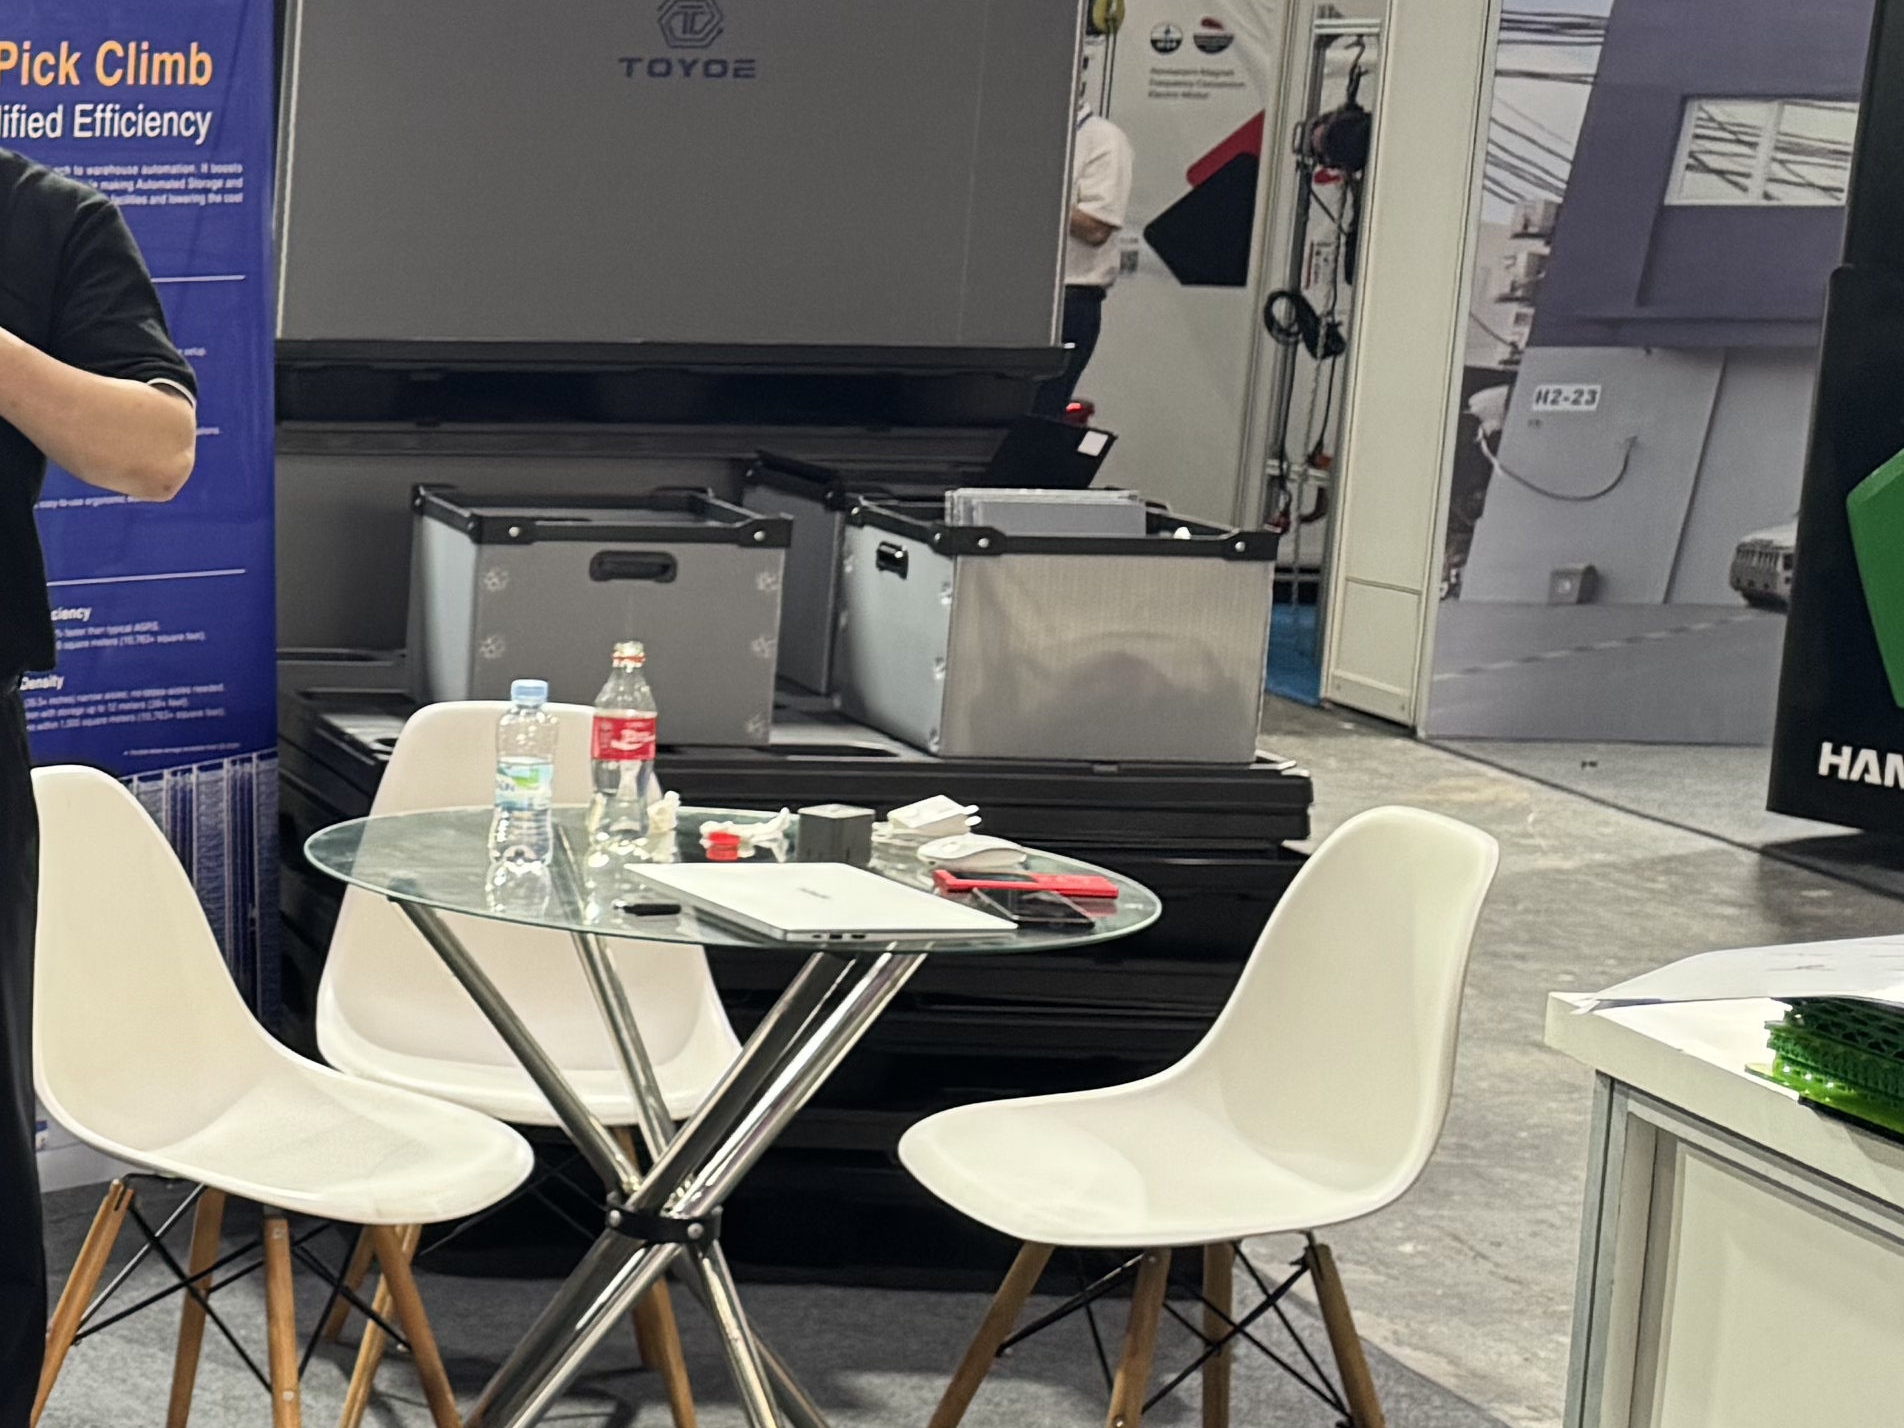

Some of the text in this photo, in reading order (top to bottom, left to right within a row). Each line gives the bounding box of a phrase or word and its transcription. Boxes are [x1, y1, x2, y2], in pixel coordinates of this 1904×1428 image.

[95, 40, 213, 87] Climb
[618, 56, 757, 79] TOYOE
[72, 103, 213, 146] Efficiency
[1534, 387, 1598, 408] H2-23
